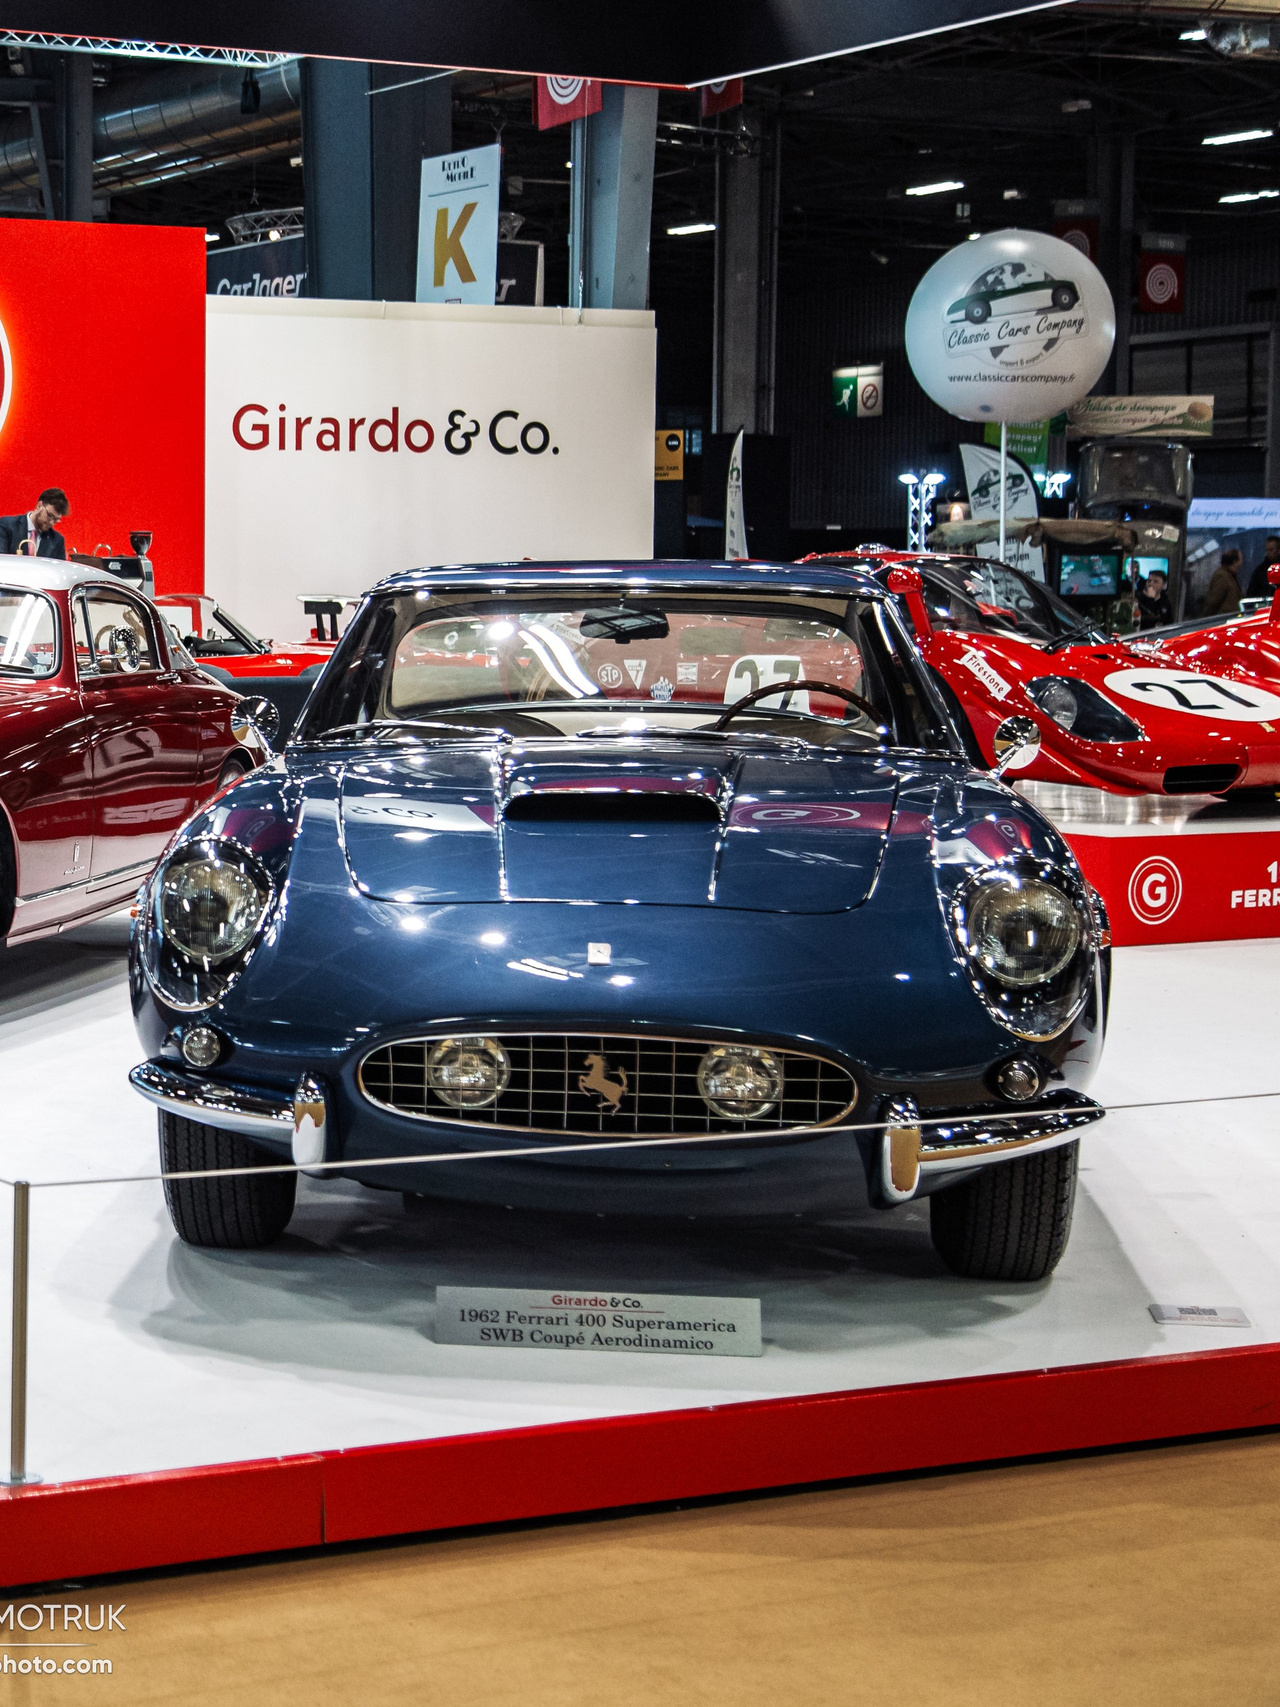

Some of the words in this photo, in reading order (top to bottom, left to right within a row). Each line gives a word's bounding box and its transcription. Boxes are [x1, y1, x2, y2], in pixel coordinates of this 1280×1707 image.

[433, 202, 479, 288] K
[948, 328, 990, 349] Classic
[998, 320, 1030, 339] Cars
[1037, 315, 1084, 337] Company
[948, 372, 1076, 385] www.classiccarscompany.fr
[232, 403, 435, 453] Girardo
[444, 409, 481, 455] &
[488, 409, 560, 455] Co.
[601, 666, 619, 684] STP
[966, 654, 1004, 693] Firestone
[1130, 679, 1261, 710] 27
[1141, 872, 1168, 908] G
[552, 1294, 608, 1308] Girardo
[610, 1297, 621, 1308] &
[622, 1298, 643, 1309] Co.
[459, 1309, 500, 1324] 1962
[505, 1311, 569, 1327] Ferrari
[575, 1313, 607, 1328] 400
[612, 1315, 737, 1334] Superamerica
[480, 1327, 524, 1343] SWB
[530, 1330, 585, 1348] Coupé
[591, 1332, 714, 1351] Aerodinamico
